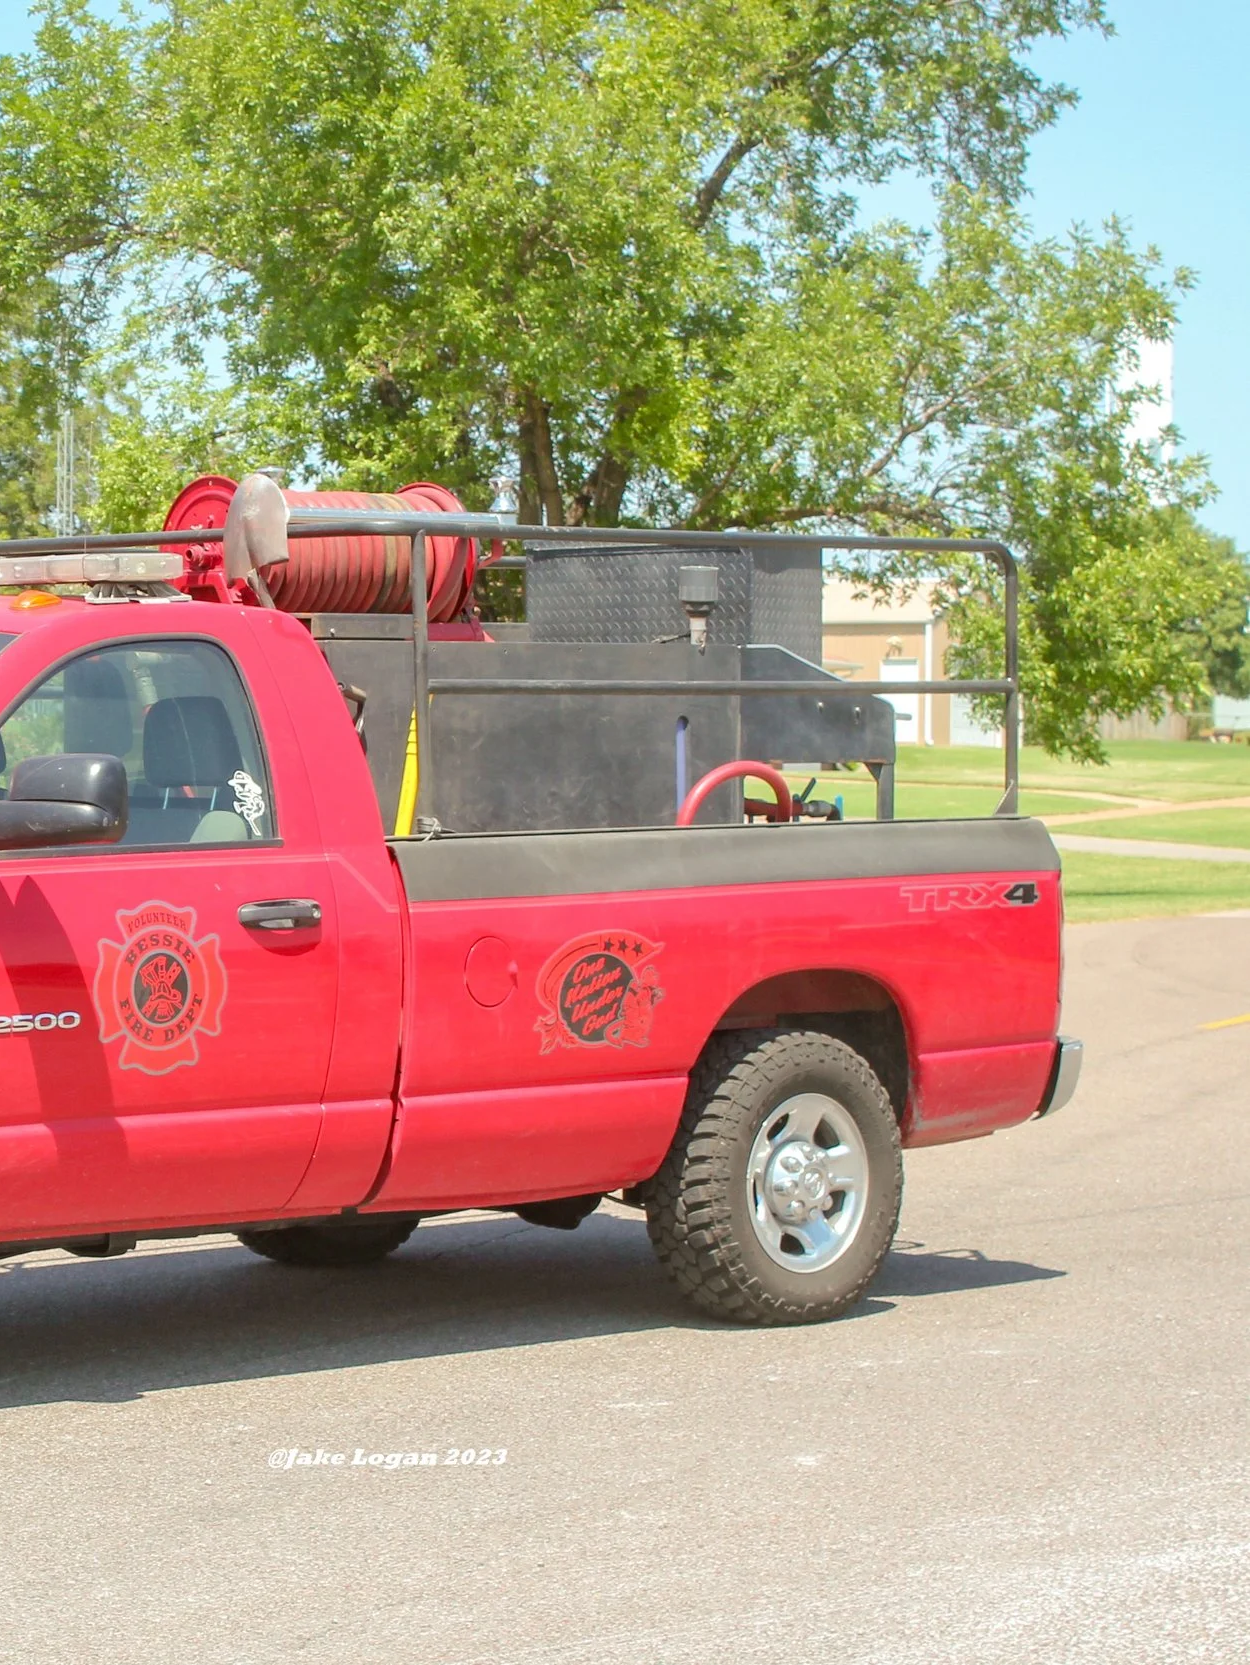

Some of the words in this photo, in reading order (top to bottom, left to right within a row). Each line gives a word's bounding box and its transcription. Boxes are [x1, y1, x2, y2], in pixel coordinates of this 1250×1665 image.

[128, 912, 187, 933] VOLUNTEER
[124, 934, 196, 966] BESSIE
[564, 966, 622, 1008] Nation
[573, 957, 607, 984] One
[119, 997, 153, 1043] FIRE
[164, 993, 203, 1043] DEPT
[571, 986, 625, 1023] Under
